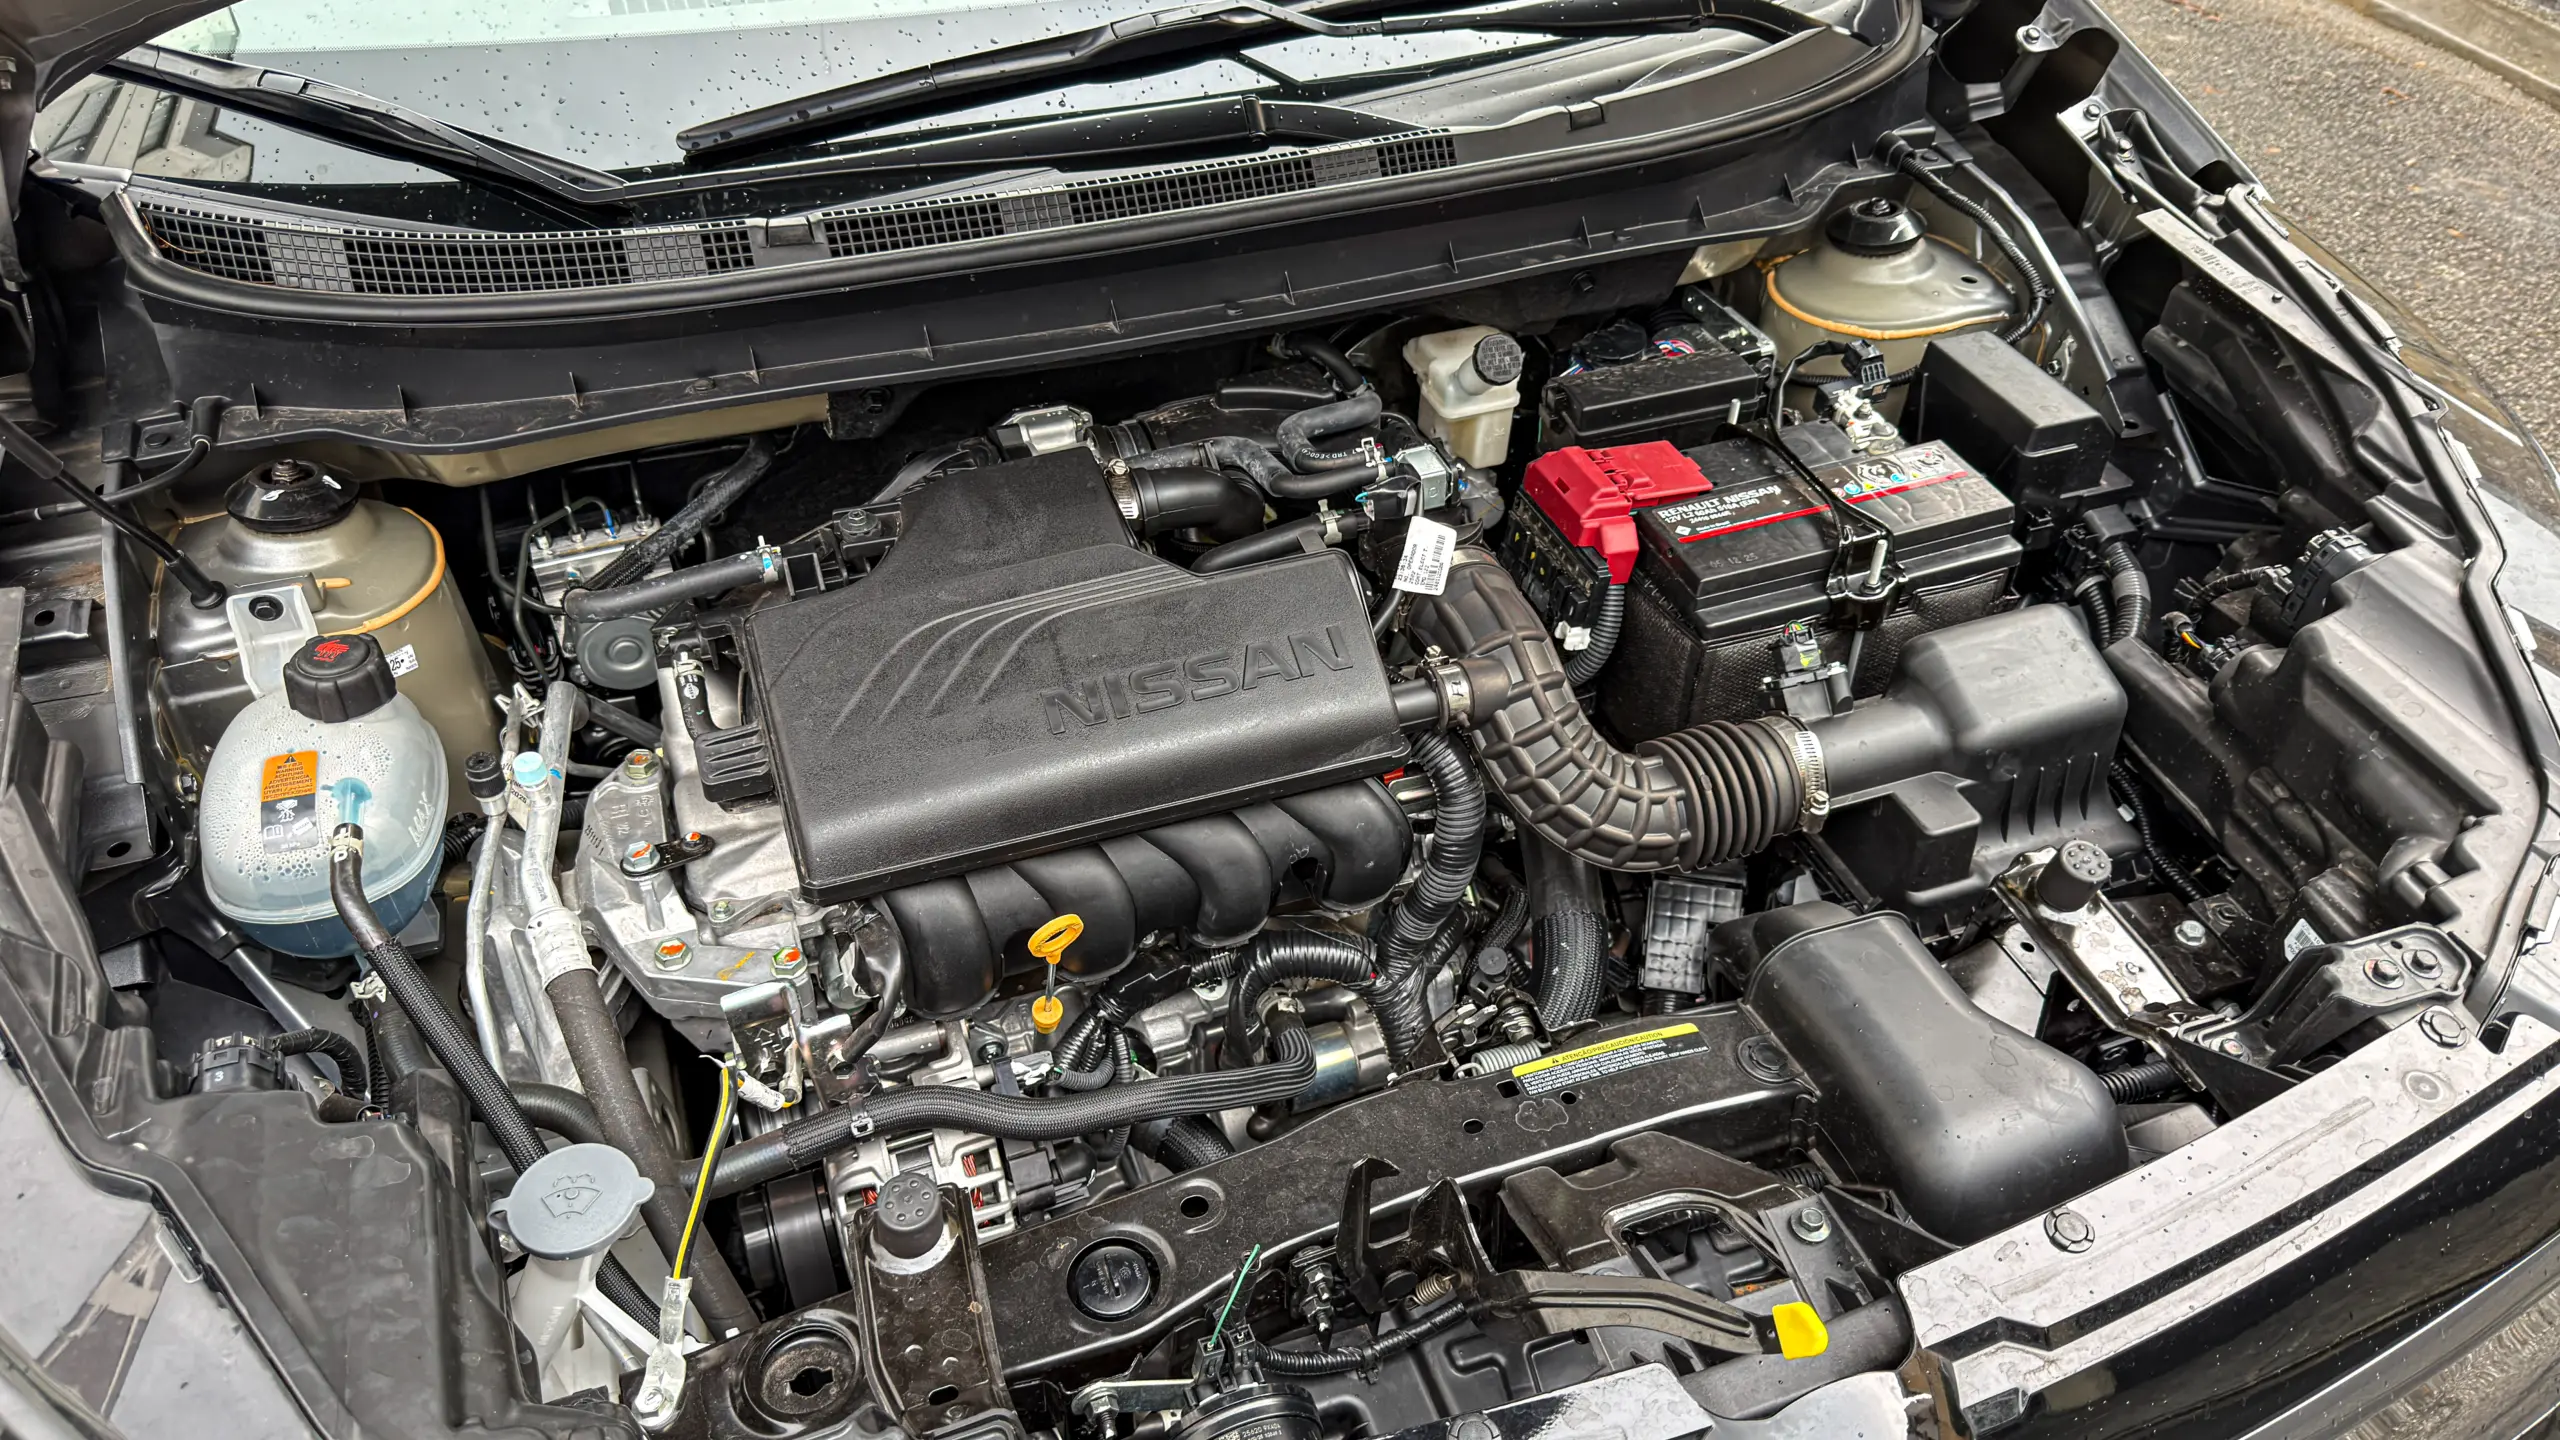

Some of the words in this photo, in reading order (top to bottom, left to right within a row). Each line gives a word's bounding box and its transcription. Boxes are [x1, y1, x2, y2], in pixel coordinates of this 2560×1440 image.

[1657, 497, 1720, 519] RENAULT
[1723, 485, 1781, 503] NISSAN
[1664, 515, 1681, 524] 12V
[1682, 511, 1695, 519] L2
[1744, 552, 1759, 562] 25
[1040, 624, 1353, 735] NISSAN
[275, 766, 303, 774] WARNING
[275, 771, 303, 779] ACHTUNG
[214, 1070, 224, 1081] 3
[1242, 1427, 1263, 1438] 25620
